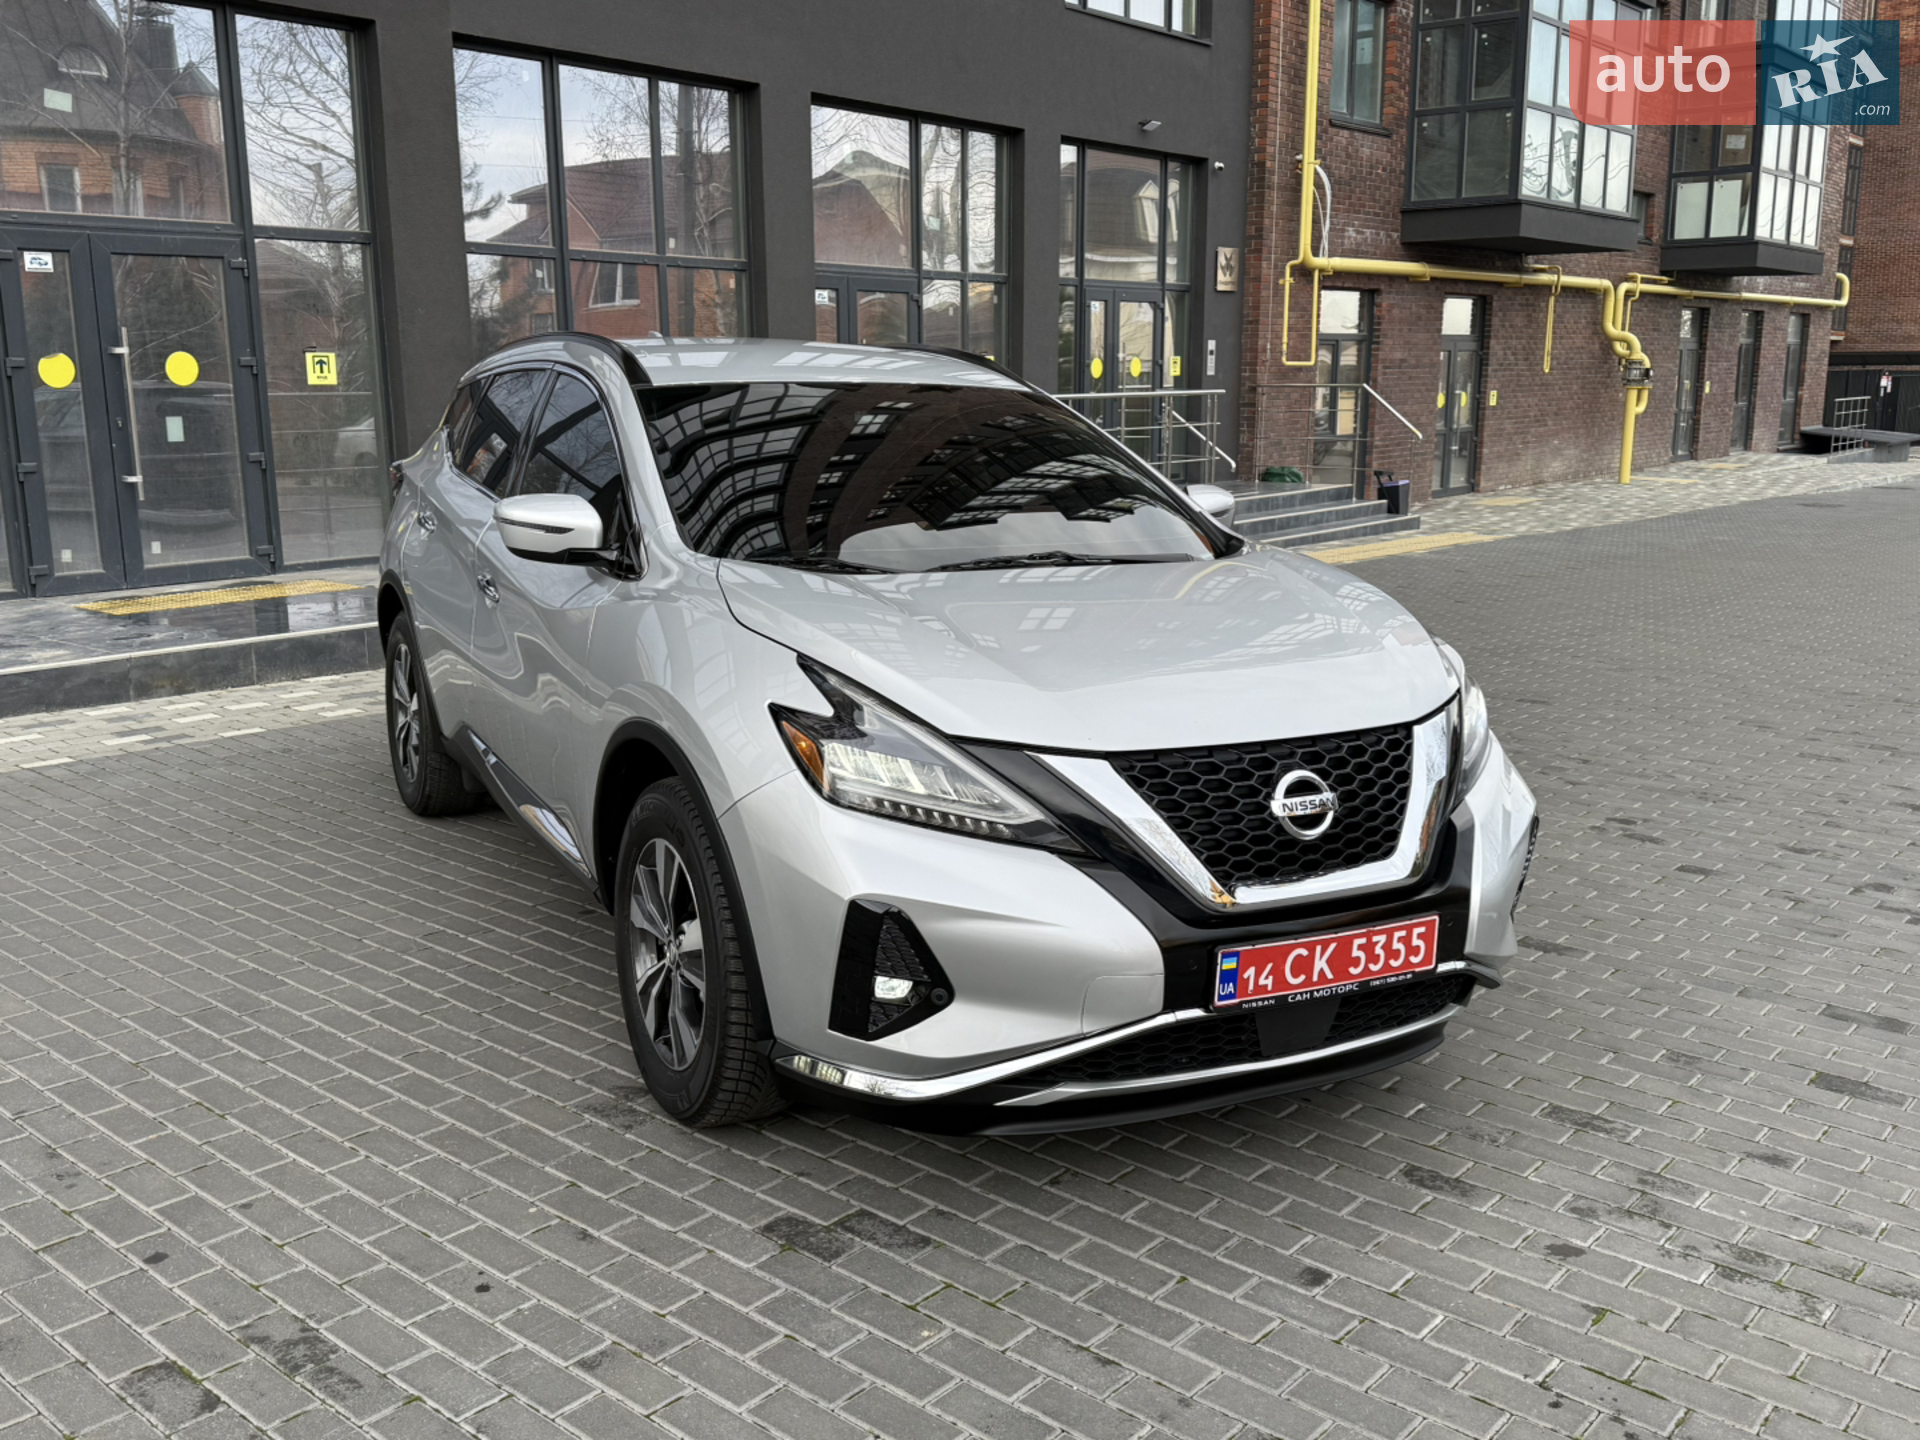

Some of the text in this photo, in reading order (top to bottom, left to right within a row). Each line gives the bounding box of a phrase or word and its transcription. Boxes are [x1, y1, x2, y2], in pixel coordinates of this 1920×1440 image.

[1282, 797, 1335, 813] NISSAN
[1242, 926, 1427, 994] 14 CK 5355
[1219, 982, 1235, 996] UA
[1242, 999, 1276, 1009] NISSAN
